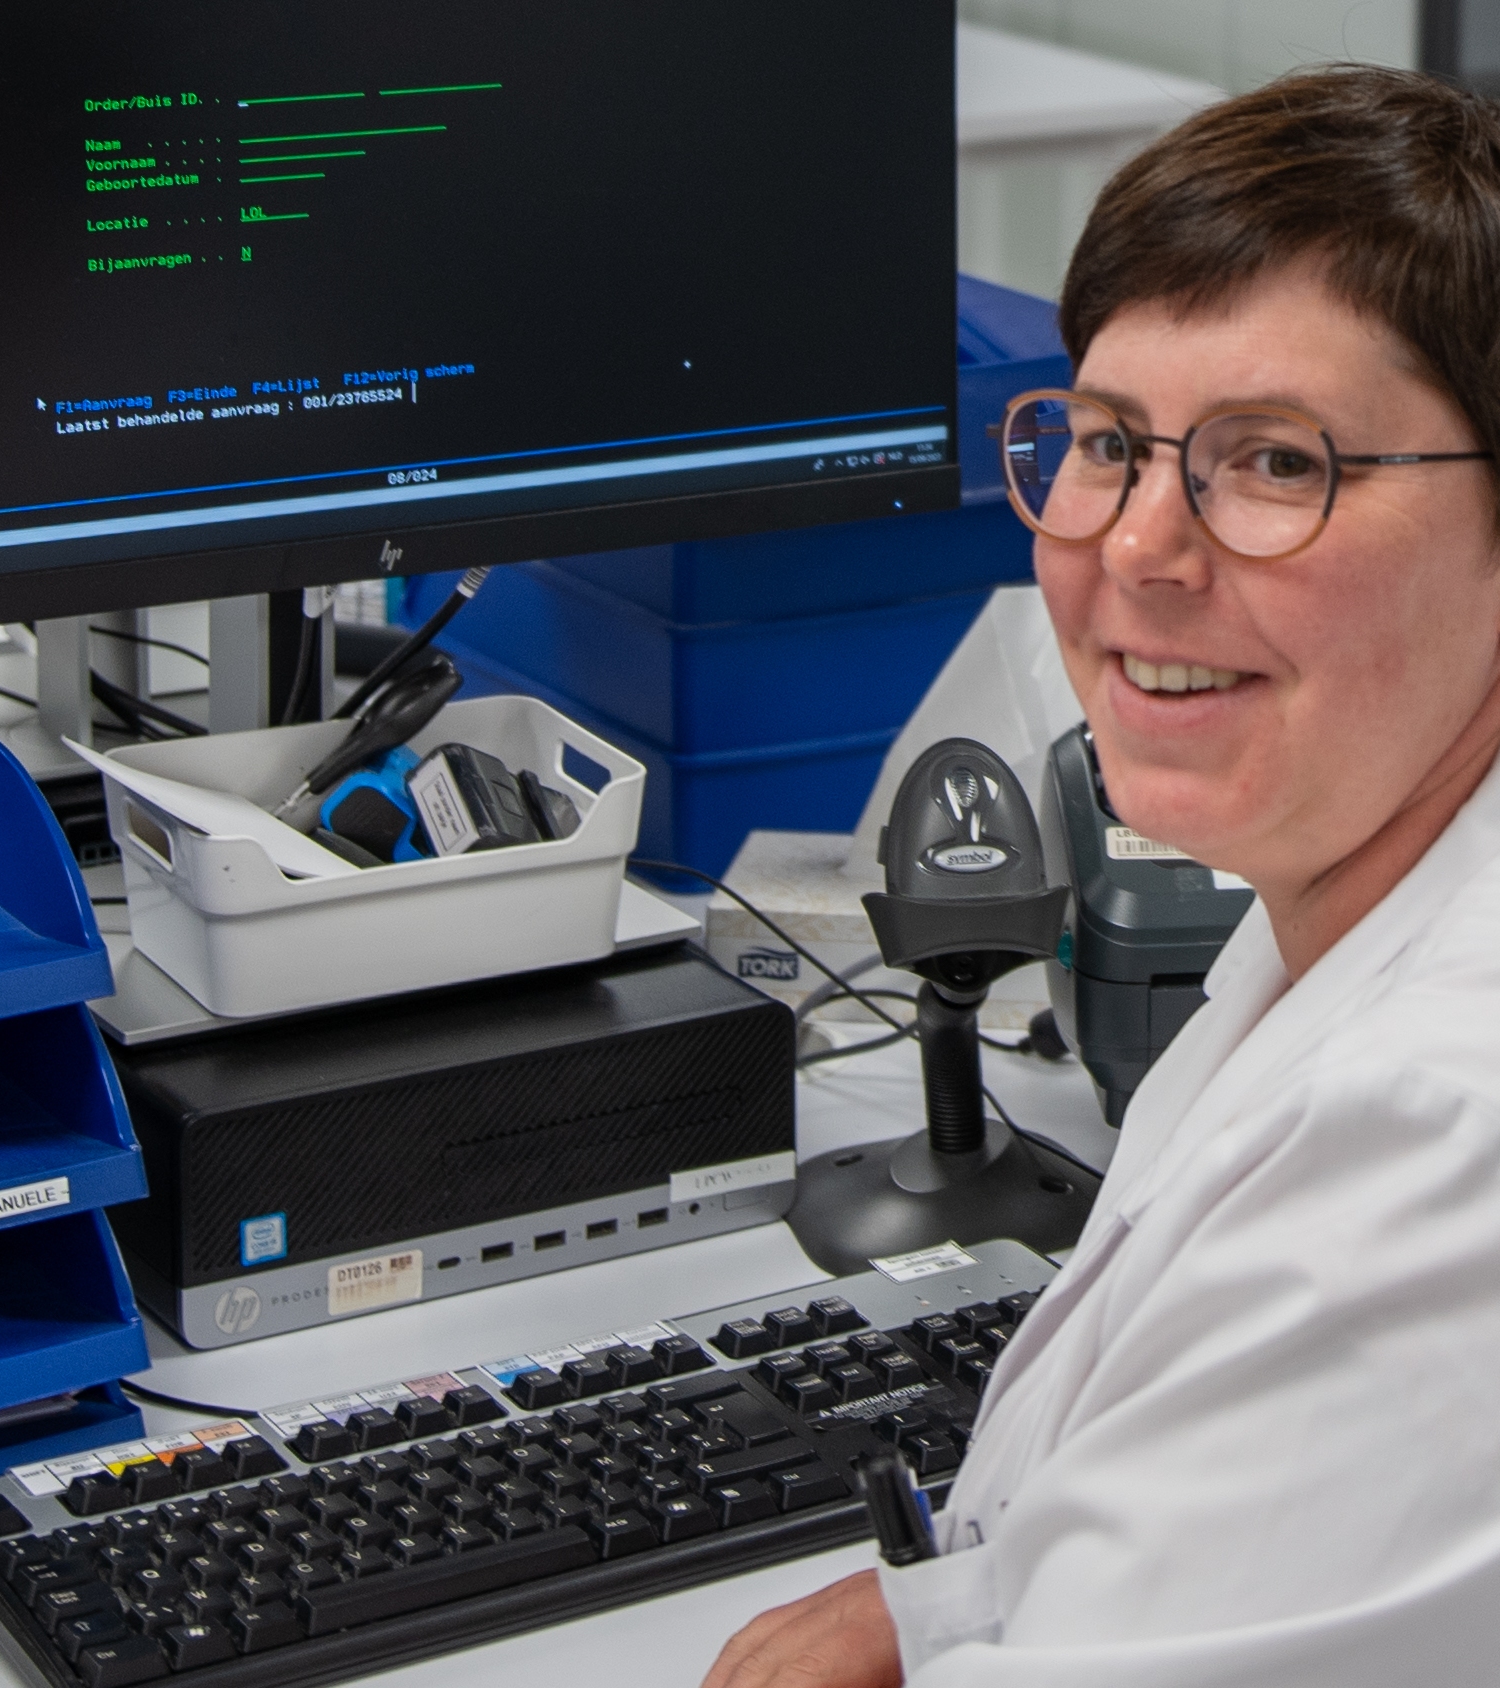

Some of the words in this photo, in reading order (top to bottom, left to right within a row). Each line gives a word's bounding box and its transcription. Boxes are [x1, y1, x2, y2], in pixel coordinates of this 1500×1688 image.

[84, 94, 172, 112] Order/Buis
[85, 139, 121, 152] Naam
[85, 157, 156, 172] Voornaam
[86, 174, 199, 192] Geboortedatum
[87, 216, 149, 232] Locatie
[87, 253, 192, 274] Bijaanvragen
[56, 395, 153, 414] F1=Aanvraag
[168, 385, 237, 403] F3=Einde
[252, 377, 320, 394] F4=Lijst
[343, 367, 419, 386] F12=Vorig
[425, 363, 475, 378] scherm
[56, 417, 110, 435] Laatst
[117, 408, 204, 429] behandelde
[211, 400, 280, 419] aanvraag
[946, 850, 993, 866] symbol
[740, 957, 796, 978] TORK
[215, 1286, 262, 1334] hp
[831, 1392, 890, 1414] IMPORTANT
[890, 1382, 930, 1399] NOTICE
